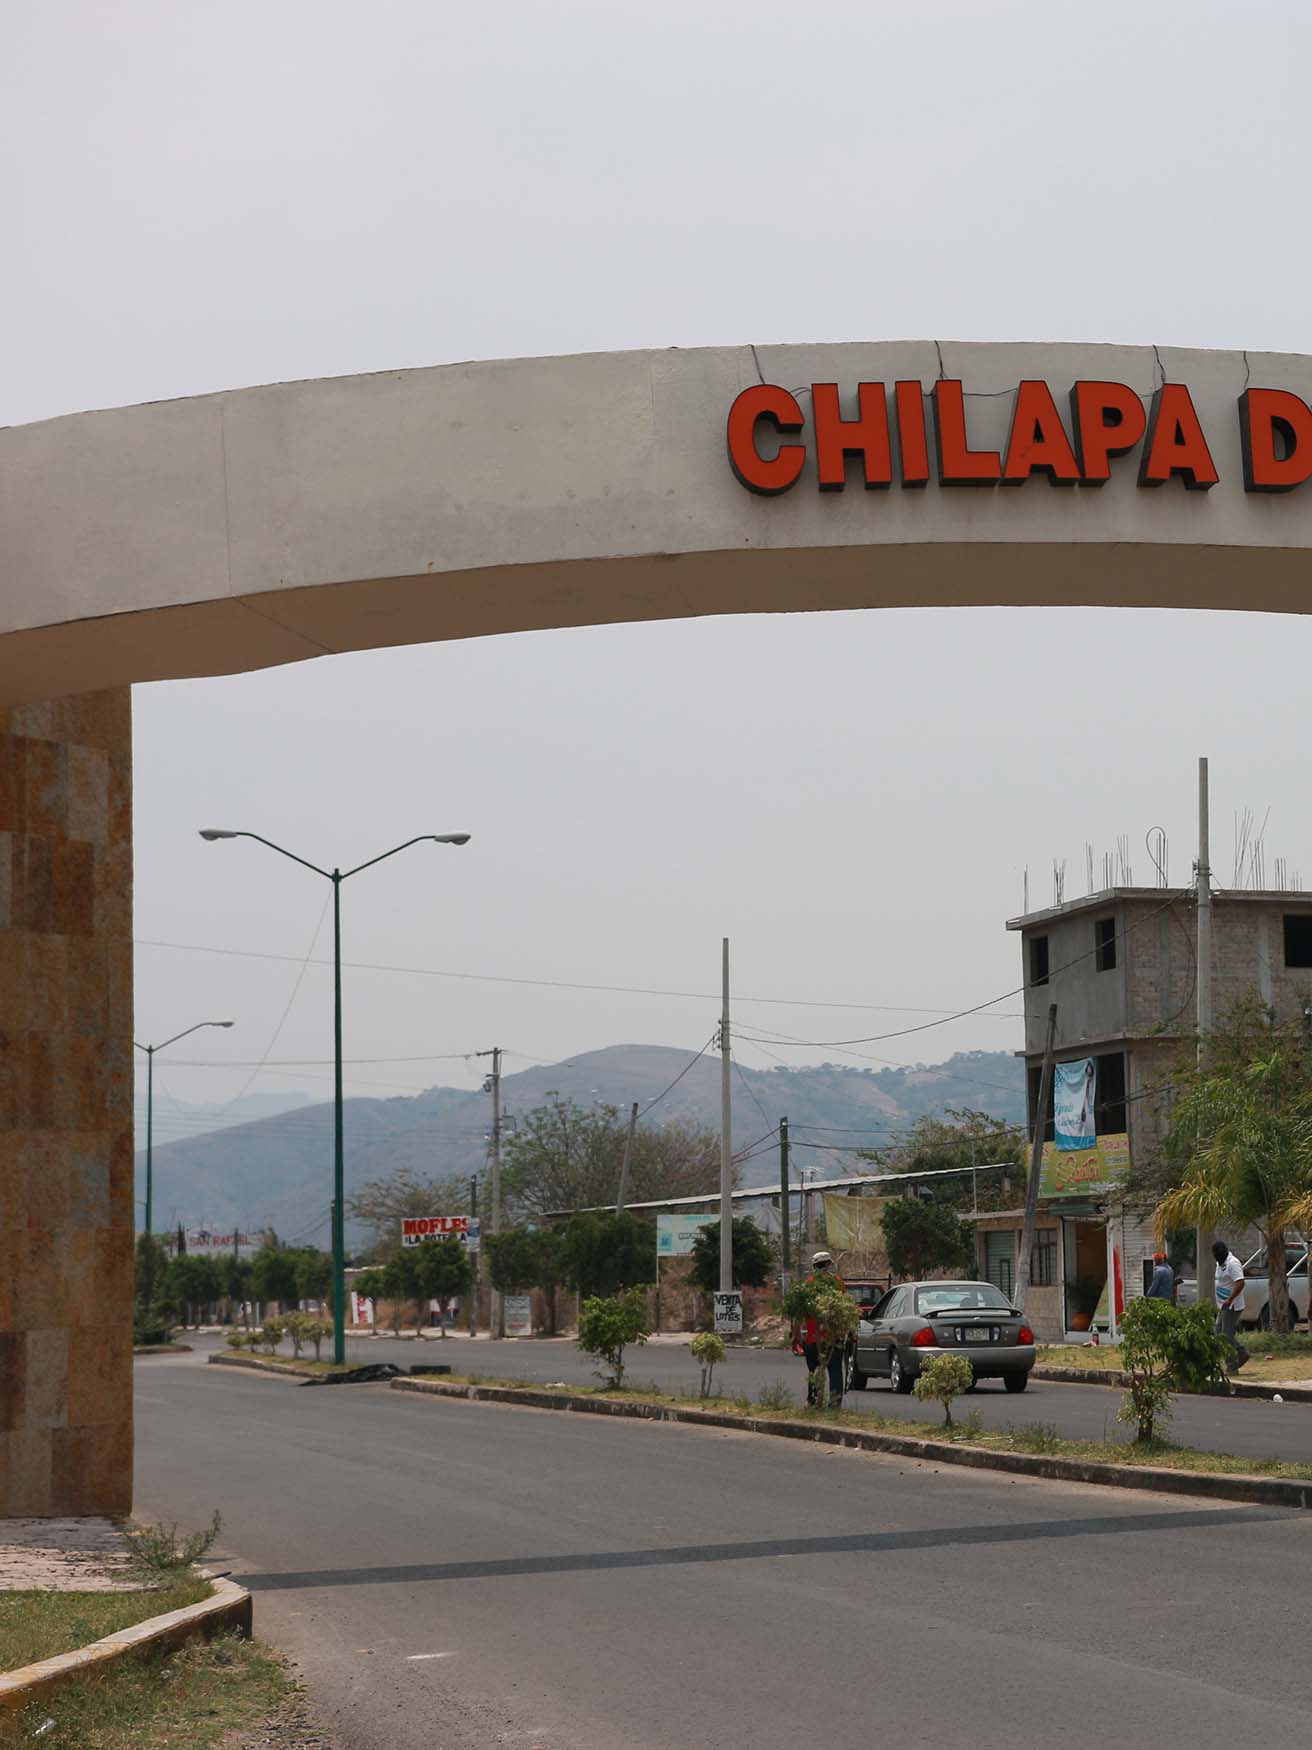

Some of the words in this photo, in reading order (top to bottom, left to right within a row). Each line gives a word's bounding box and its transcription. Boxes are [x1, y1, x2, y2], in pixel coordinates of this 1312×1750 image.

[726, 379, 1220, 496] CHILAPA
[403, 1216, 468, 1235] MOFLES
[190, 1236, 209, 1247] SAN
[714, 1294, 742, 1307] VENTA
